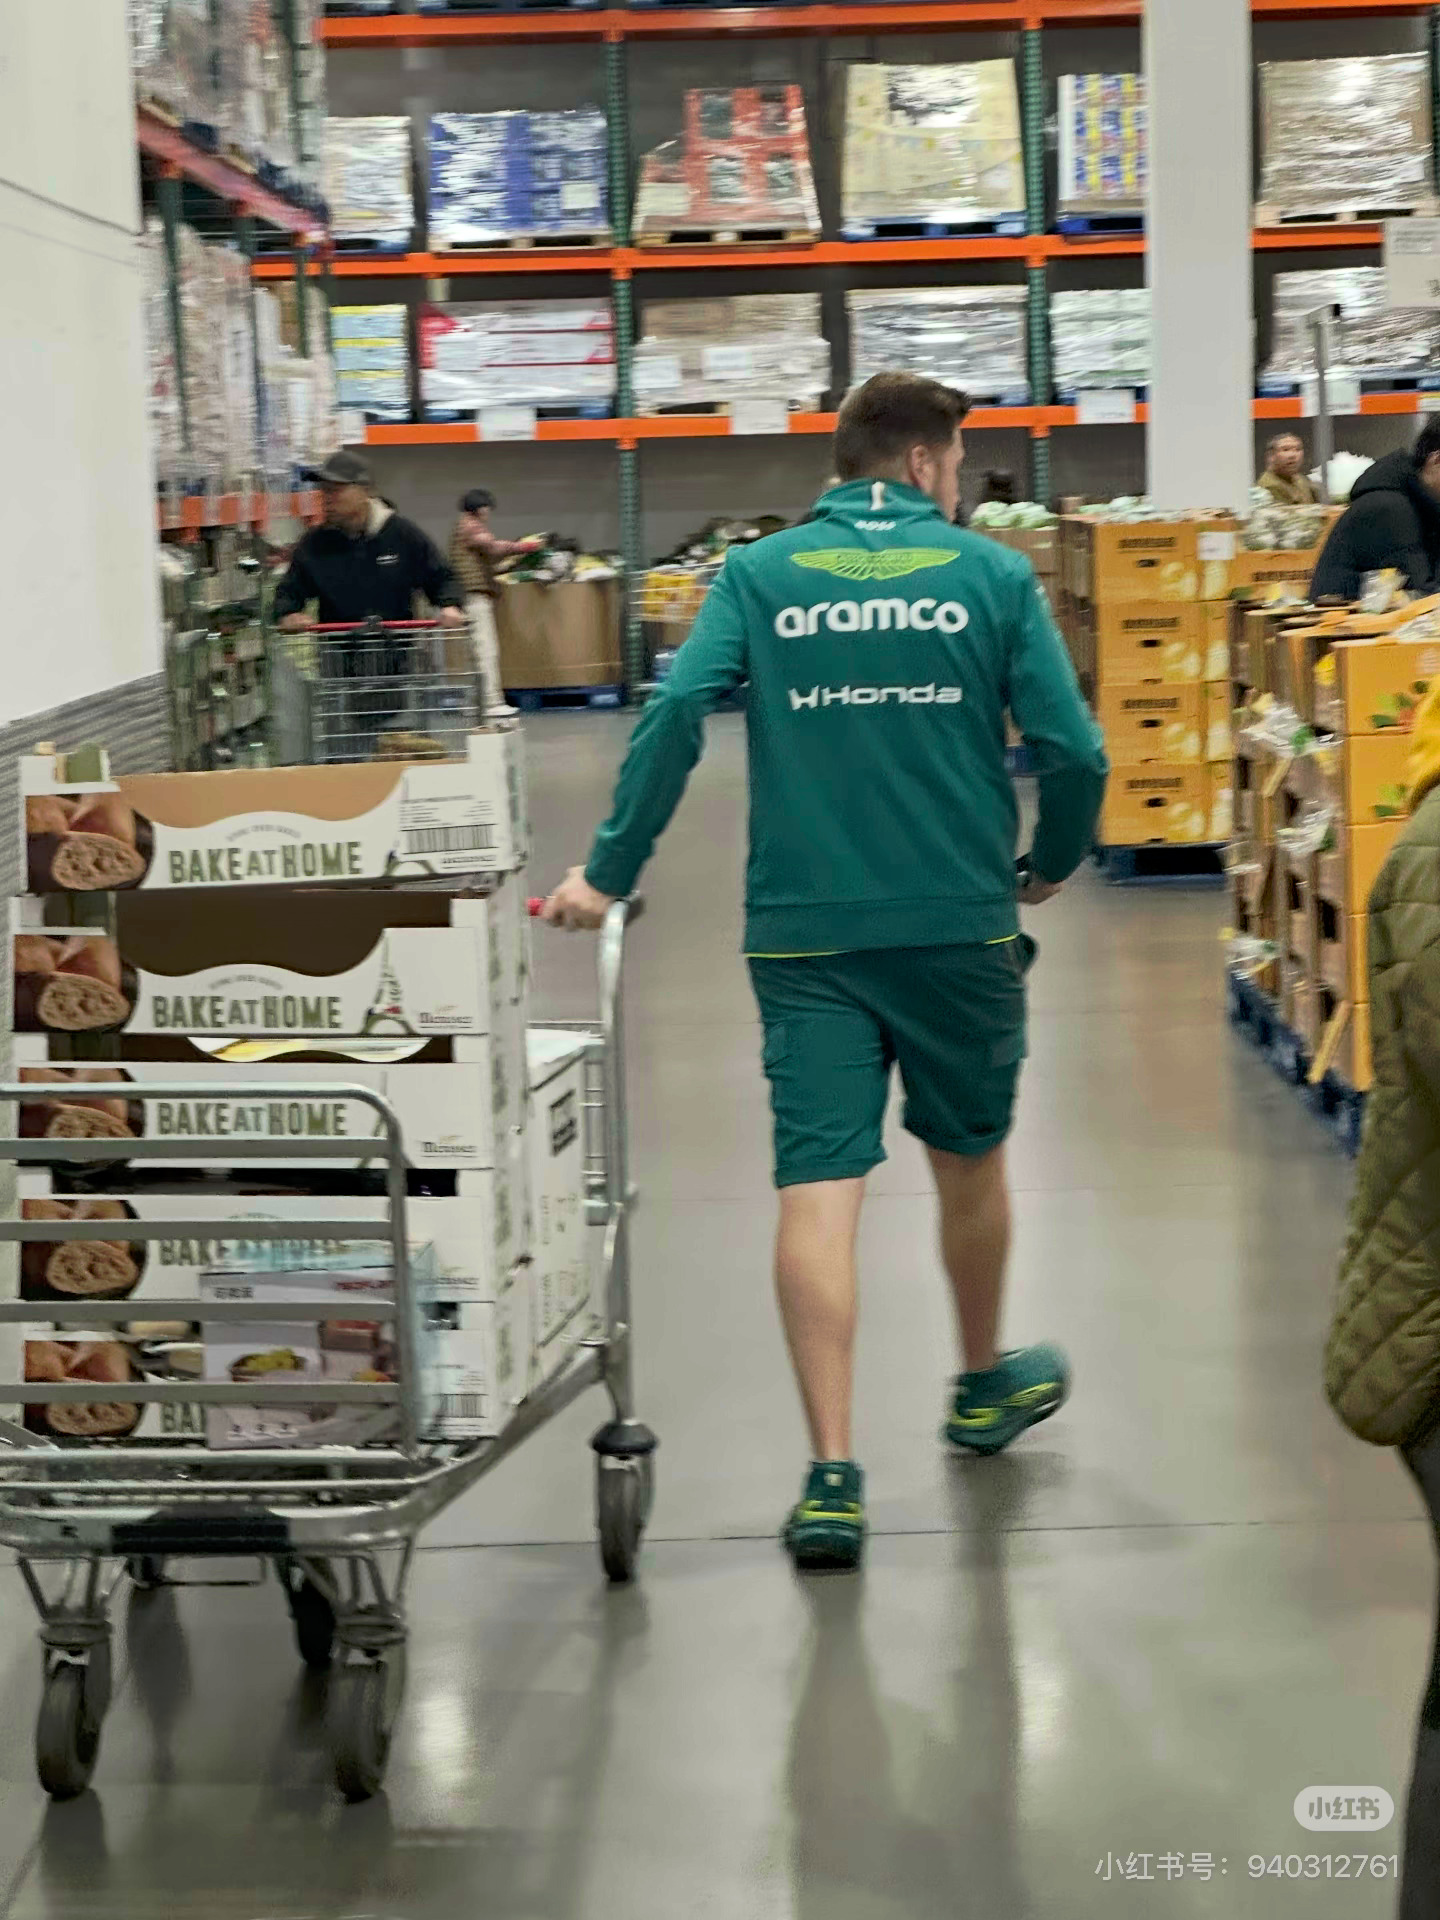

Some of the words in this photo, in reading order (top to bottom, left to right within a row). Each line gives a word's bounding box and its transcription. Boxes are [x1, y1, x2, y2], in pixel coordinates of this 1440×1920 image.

[774, 598, 969, 638] aramco
[821, 682, 963, 706] Honda
[169, 848, 243, 883] BAKE
[247, 850, 276, 876] AT
[280, 842, 362, 878] HOME
[152, 996, 225, 1028] BAKE
[228, 999, 259, 1025] AT
[262, 996, 342, 1028] HOME
[157, 1102, 230, 1135] BAKE
[233, 1106, 266, 1132] AT
[268, 1102, 348, 1136] HOME
